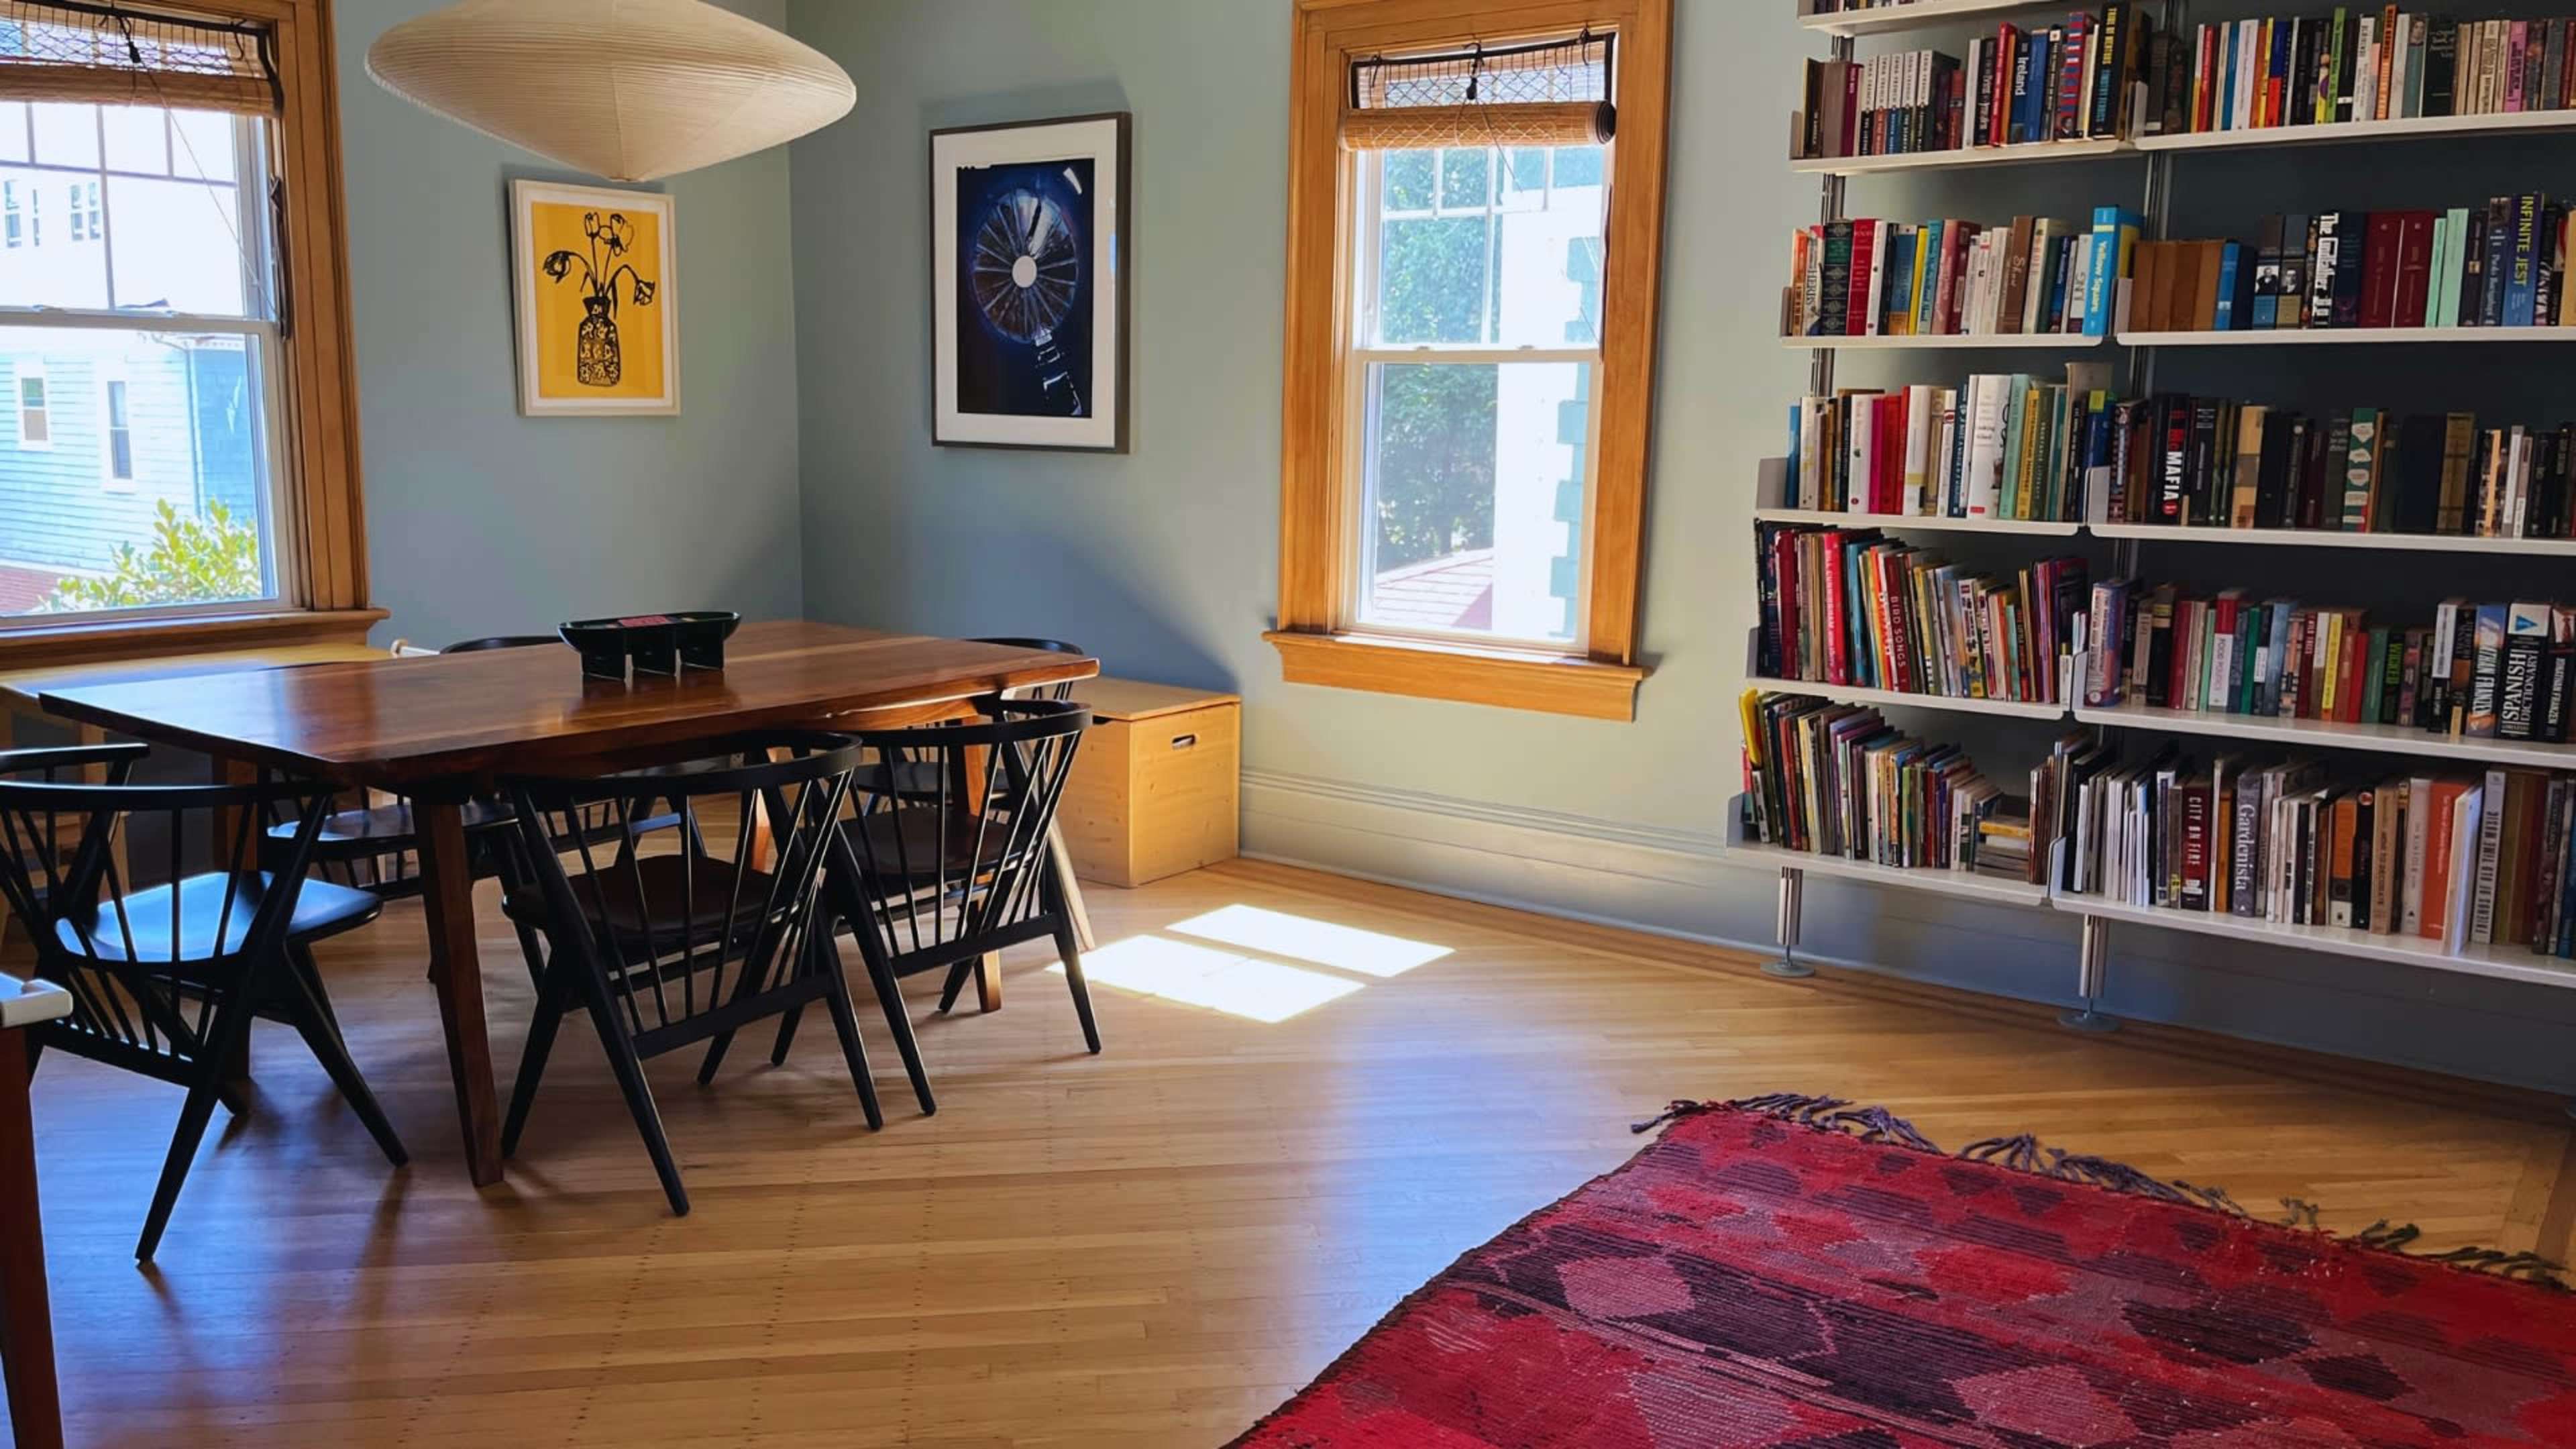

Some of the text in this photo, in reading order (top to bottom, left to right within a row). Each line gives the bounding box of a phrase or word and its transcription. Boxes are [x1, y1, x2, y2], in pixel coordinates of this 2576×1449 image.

[2015, 56, 2029, 96] Ireland
[2320, 213, 2339, 235] The
[2516, 196, 2534, 253] INFINITE
[1806, 268, 1819, 306] HERBS
[2089, 241, 2108, 313] Yellow Square
[2514, 256, 2529, 286] JEST
[1890, 595, 1907, 667] BIRD SONGS
[2502, 653, 2527, 720] SPANISH
[2519, 653, 2538, 721] DICTIONARY
[2187, 796, 2203, 867] CITY ON FIRE
[2235, 804, 2256, 891] Gardenista
[2483, 810, 2500, 839] MUSIC
[2481, 842, 2497, 864] TIME
[2474, 898, 2491, 934] FRIENDS
